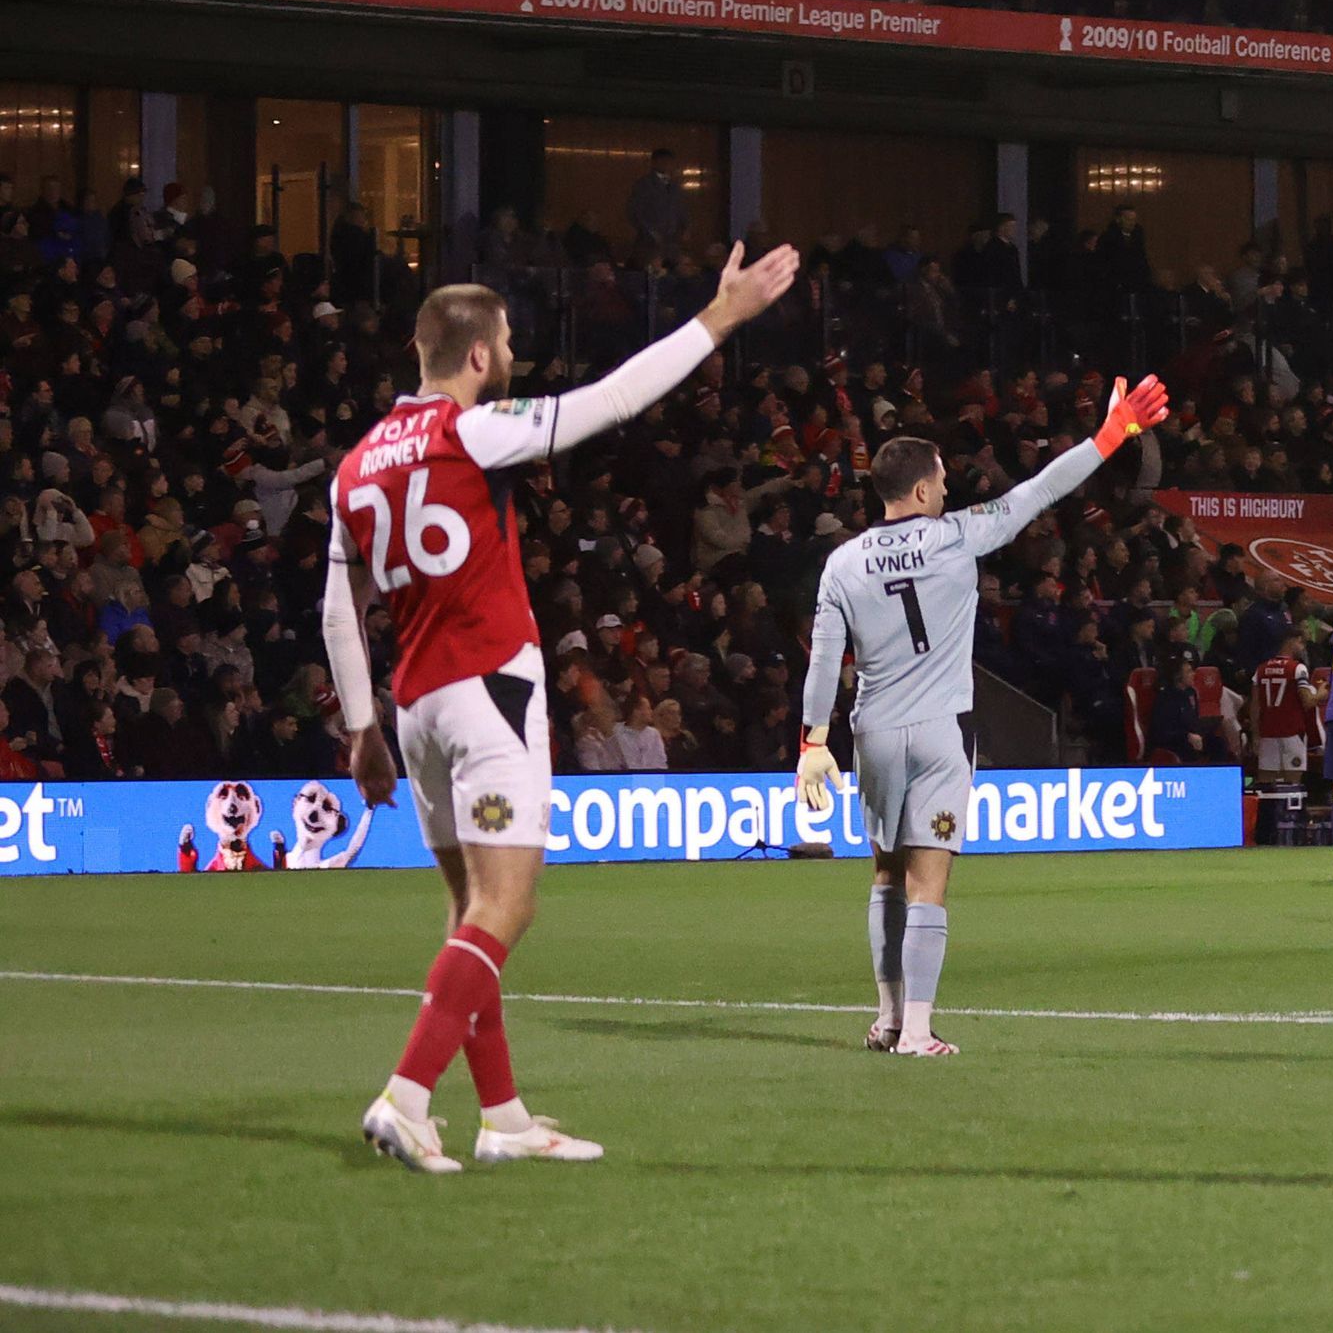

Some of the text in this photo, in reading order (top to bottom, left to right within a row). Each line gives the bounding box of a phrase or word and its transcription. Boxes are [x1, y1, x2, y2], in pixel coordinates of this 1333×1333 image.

[799, 2, 865, 31] League
[870, 8, 941, 36] Premier
[1082, 25, 1158, 52] 2009/10
[1163, 29, 1231, 57] Football
[1235, 34, 1332, 63] Conference
[369, 408, 438, 444] BOXT
[359, 433, 430, 479] ROONEY
[1190, 496, 1305, 520] THIS IS HIGHBURY
[348, 467, 471, 594] 26
[861, 528, 927, 550] BOXT
[866, 549, 925, 575] LYNCH
[884, 578, 931, 655] 1
[1260, 677, 1288, 707] 17
